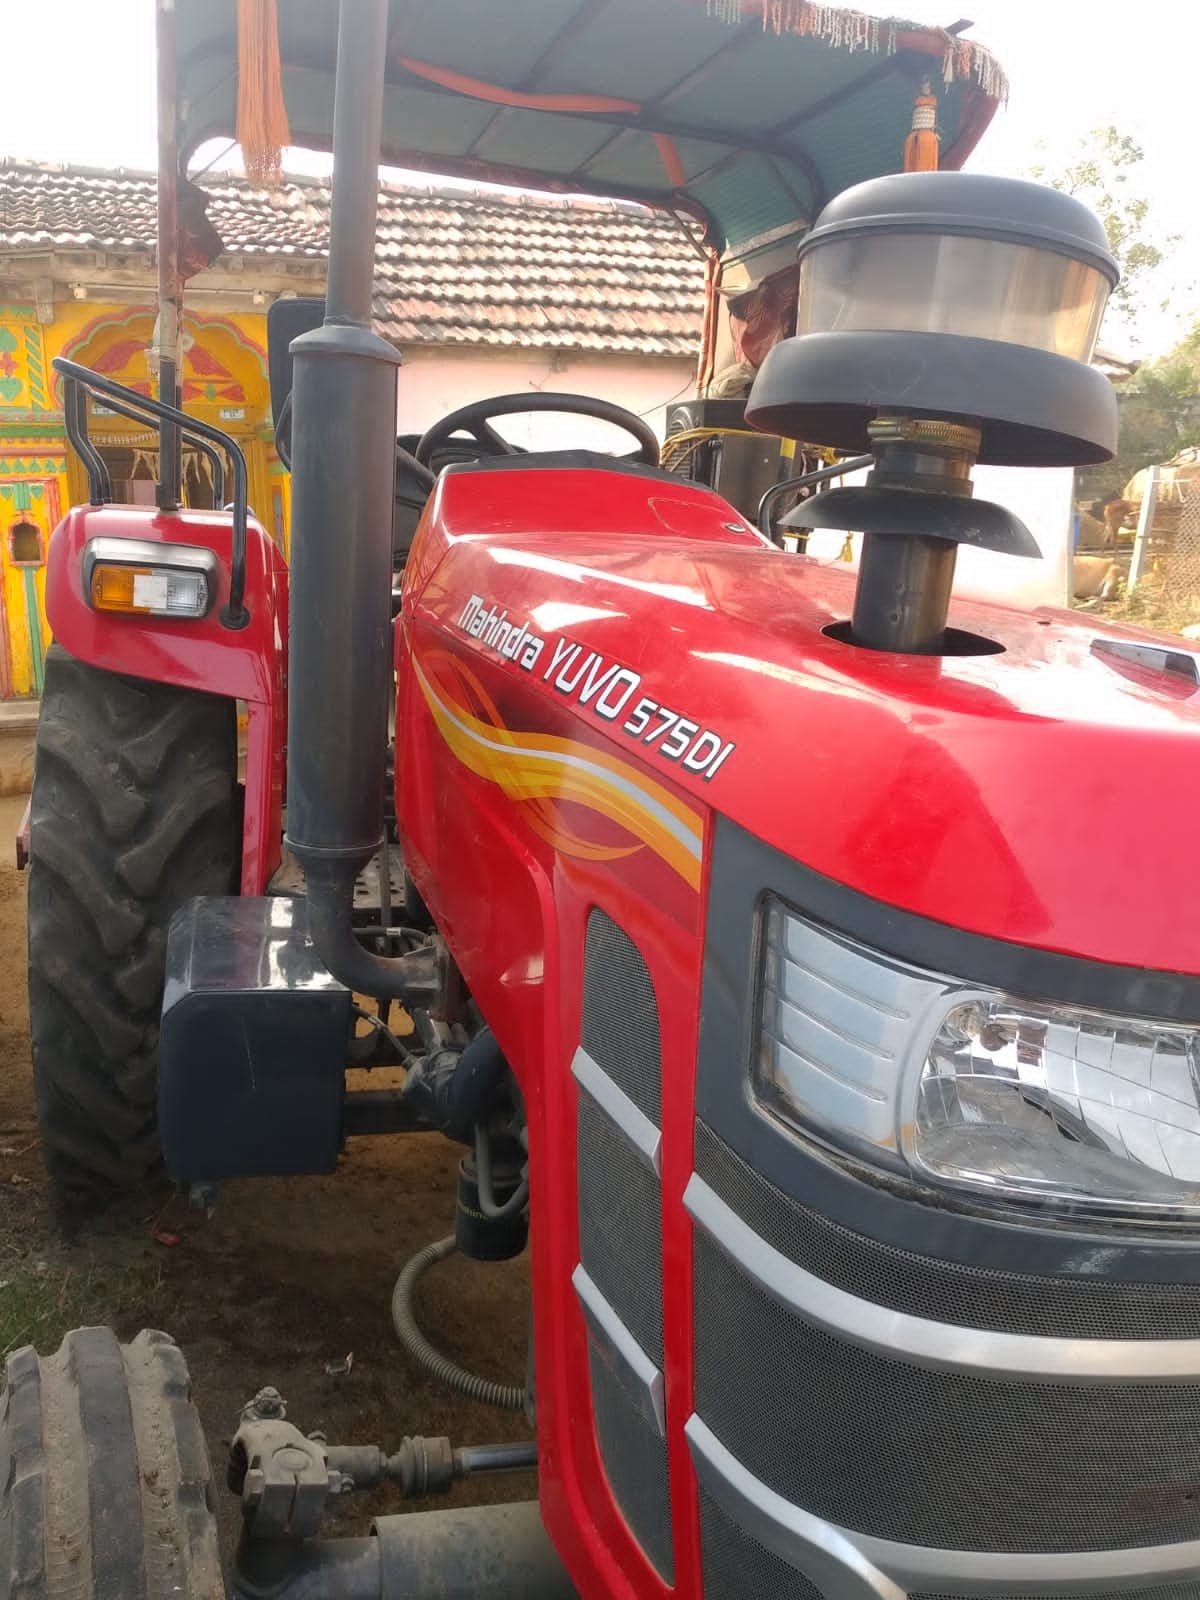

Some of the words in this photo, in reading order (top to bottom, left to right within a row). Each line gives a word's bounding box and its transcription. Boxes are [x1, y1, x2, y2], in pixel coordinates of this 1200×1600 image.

[457, 594, 545, 671] Mahindra
[543, 637, 641, 722] YUVO
[623, 697, 736, 783] 575DI
